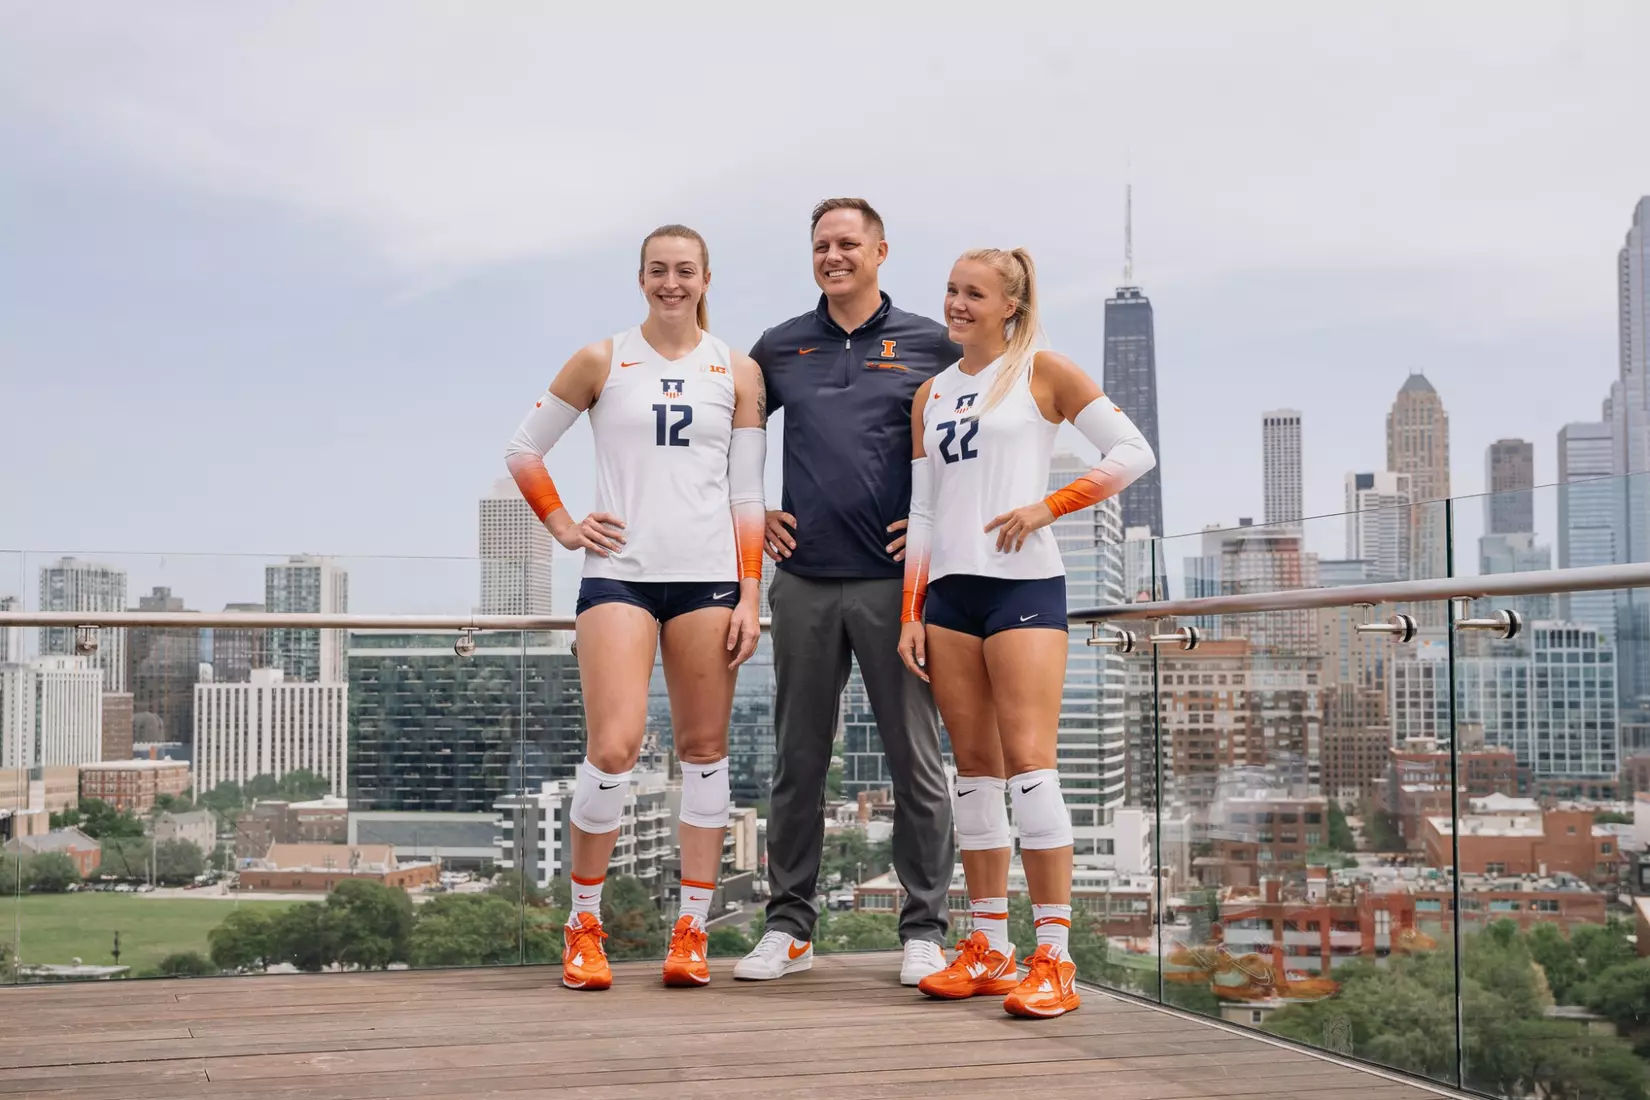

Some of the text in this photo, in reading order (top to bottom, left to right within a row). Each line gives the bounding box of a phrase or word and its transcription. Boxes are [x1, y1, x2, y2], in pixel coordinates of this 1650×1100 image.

[881, 340, 896, 357] I
[652, 403, 693, 447] 12
[936, 415, 980, 464] 22
